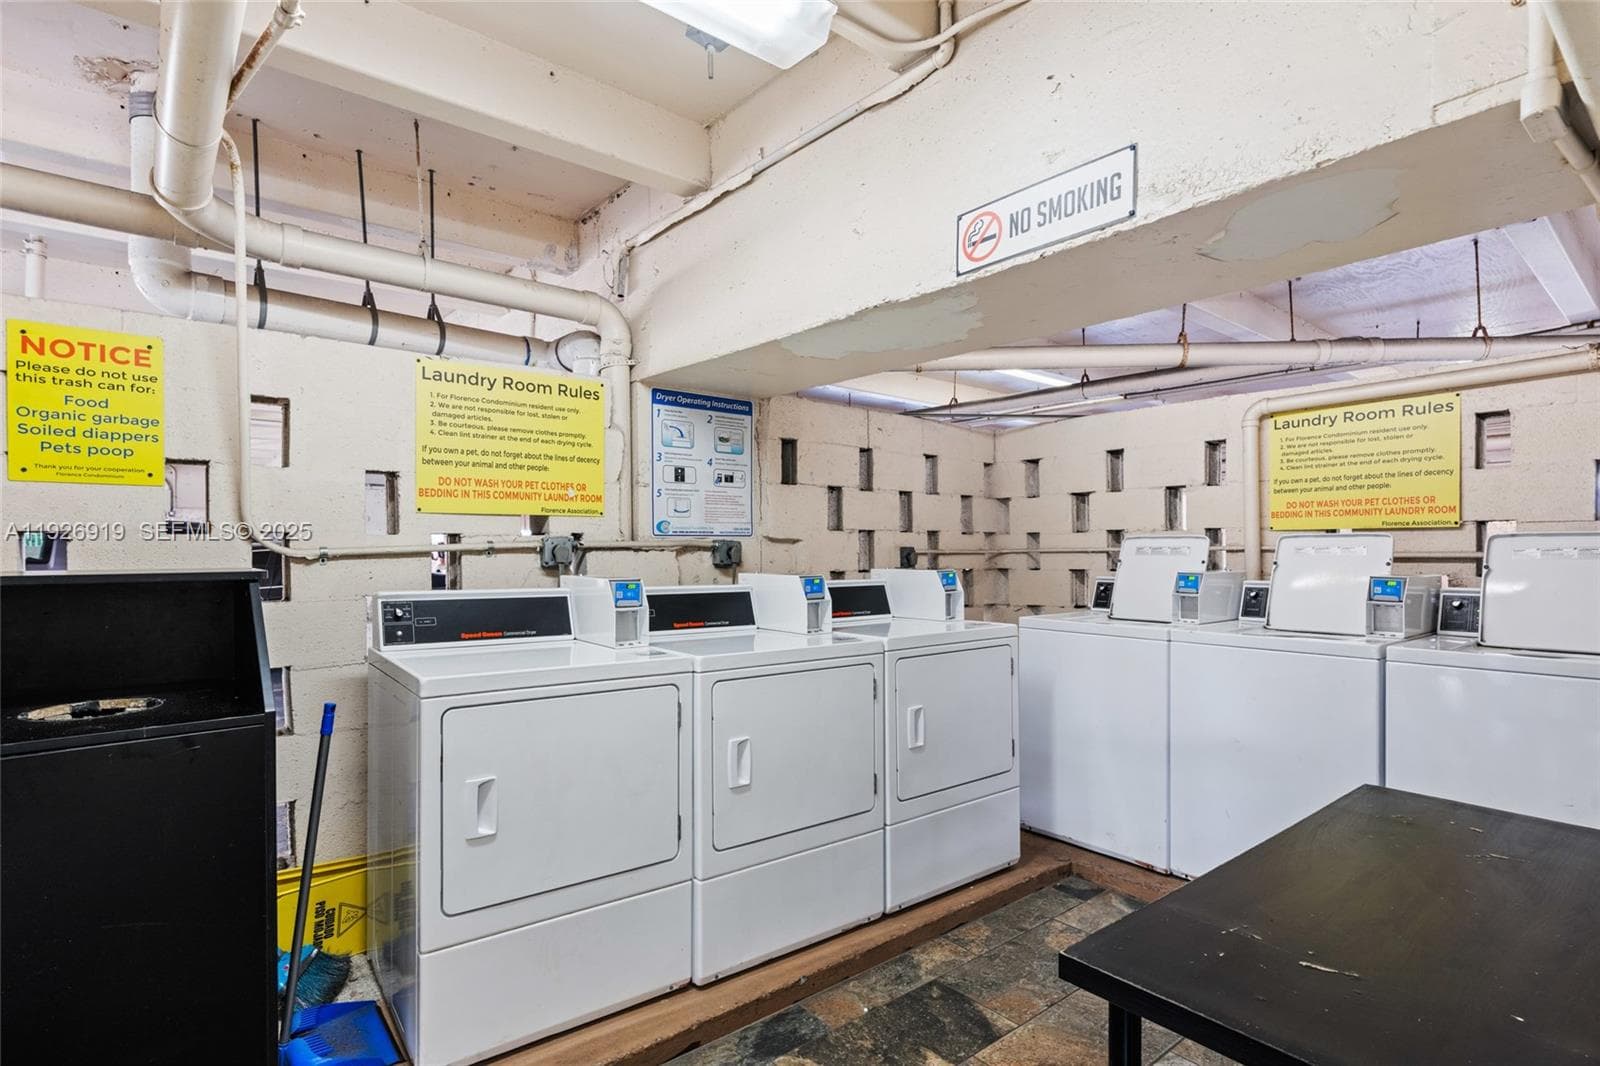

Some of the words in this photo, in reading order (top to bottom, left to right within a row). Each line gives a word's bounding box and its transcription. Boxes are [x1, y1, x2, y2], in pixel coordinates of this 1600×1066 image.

[1008, 206, 1031, 238] NO
[1037, 172, 1122, 228] SMOKING
[20, 334, 152, 367] NOTICE
[15, 360, 70, 374] Please
[75, 366, 96, 377] do
[101, 371, 128, 380] not
[132, 374, 157, 383] use
[15, 372, 46, 384] this
[52, 376, 92, 388] trash
[97, 382, 125, 391] can
[130, 383, 155, 394] for:
[421, 366, 496, 392] Laundry
[502, 376, 552, 394] Room
[558, 382, 600, 400] Rules
[64, 395, 108, 408] Food
[449, 394, 480, 402] Florence
[656, 392, 675, 402] Dryer
[676, 394, 710, 408] Operating
[711, 400, 749, 411] Instructions
[16, 406, 86, 421] Organic
[92, 414, 159, 428] garbage
[431, 410, 465, 420] damaged
[1274, 413, 1337, 430] Laundry
[1343, 408, 1395, 422] Room
[1402, 401, 1454, 416] Rules
[17, 422, 76, 437] Soiled
[82, 427, 158, 443] diappers
[40, 441, 81, 454] Pets
[87, 446, 134, 459] poop
[556, 439, 575, 447] drying
[422, 456, 454, 465] between
[454, 460, 470, 468] your
[428, 447, 441, 455] you
[503, 450, 523, 460] forget
[524, 452, 542, 460] about
[576, 455, 600, 466] decency
[438, 476, 451, 485] DO
[453, 476, 472, 486] NOT
[474, 478, 498, 487] WASH
[500, 479, 523, 488] YOUR
[524, 480, 539, 489] PET
[575, 482, 586, 491] OR
[1343, 473, 1363, 482] forget
[418, 487, 459, 498] BEDDING
[461, 489, 471, 498] IN
[472, 490, 491, 499] THIS
[492, 490, 541, 500] COMMUNITY
[579, 494, 601, 502] ROOM
[1316, 499, 1338, 508] WASH
[1339, 498, 1362, 507] YOUR
[1364, 497, 1378, 506] PET
[1381, 496, 1421, 505] CLOTHES
[1422, 495, 1435, 503] OR
[1332, 507, 1382, 516] COMMUNITY
[1384, 506, 1426, 515] LAUNDRY
[1427, 505, 1456, 513] ROOM
